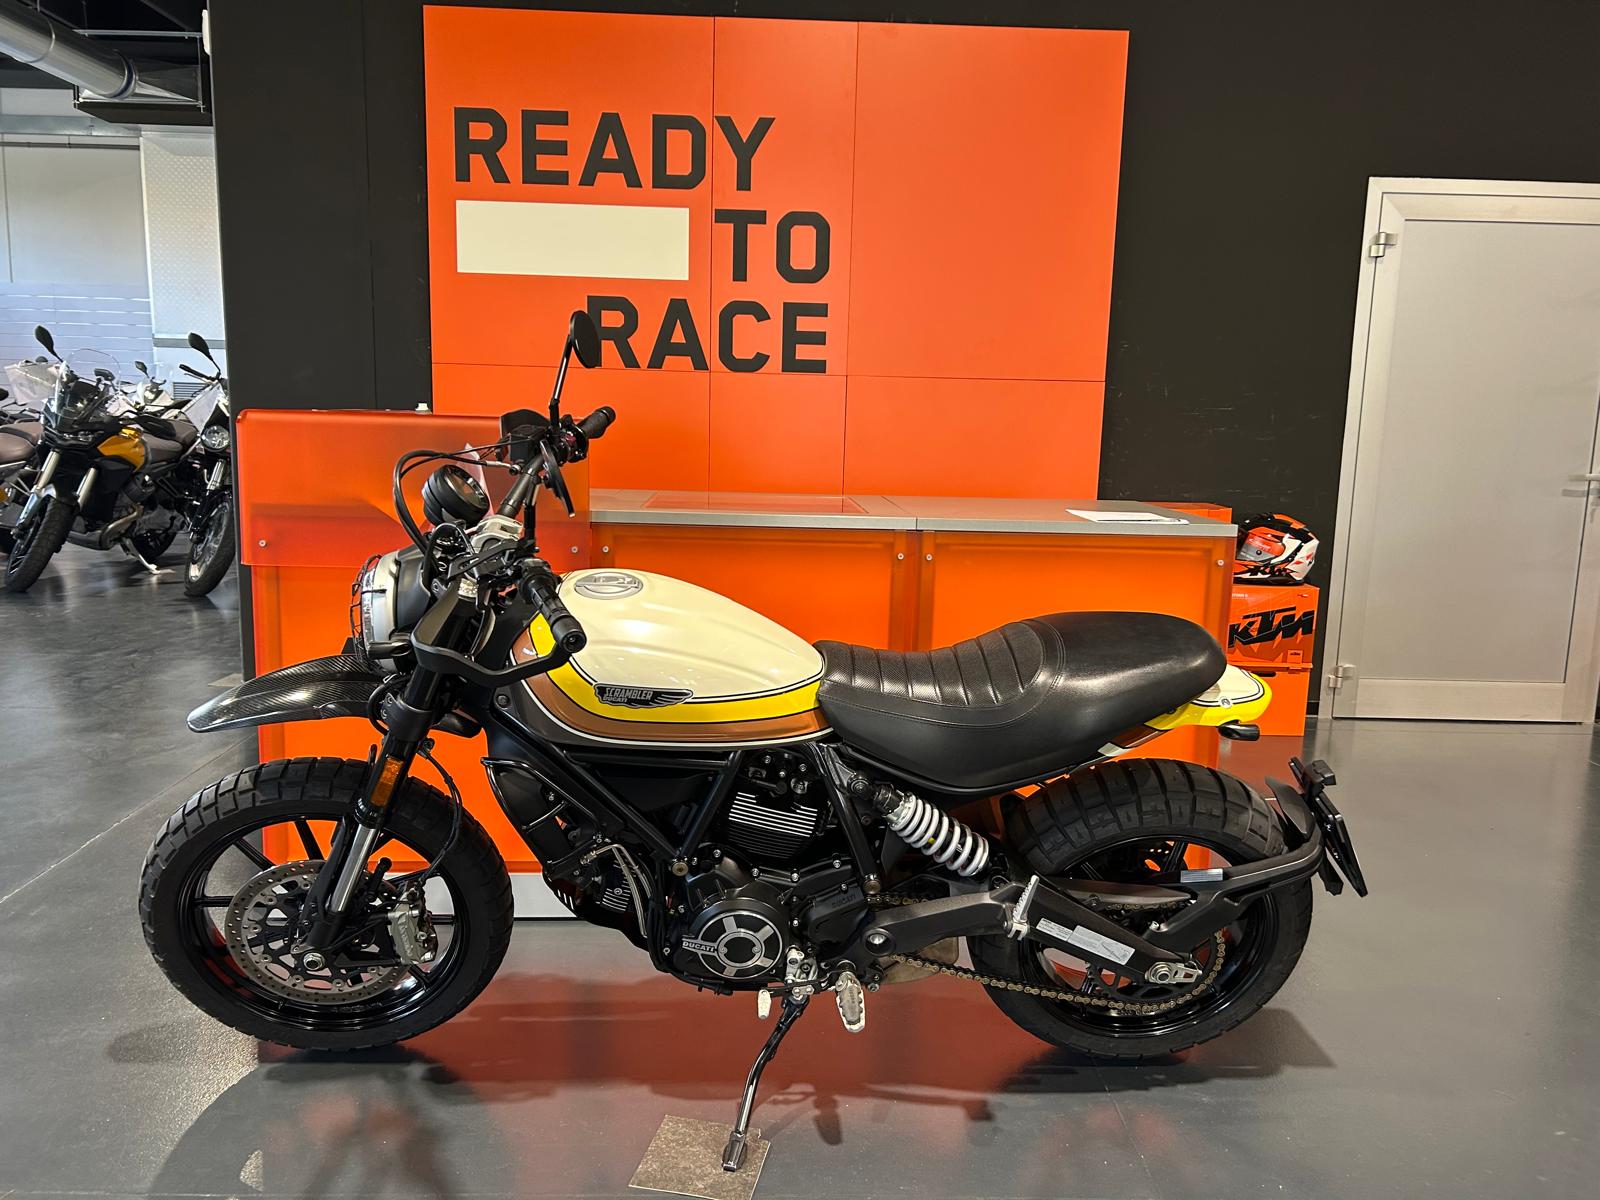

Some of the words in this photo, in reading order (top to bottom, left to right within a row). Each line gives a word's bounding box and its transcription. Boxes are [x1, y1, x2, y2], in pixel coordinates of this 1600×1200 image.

[453, 106, 776, 192] READY
[714, 208, 831, 284] TO
[586, 295, 829, 374] RACE
[1228, 606, 1315, 648] KTM
[605, 687, 653, 700] SCRAMBLER
[682, 941, 715, 952] DUCATI
